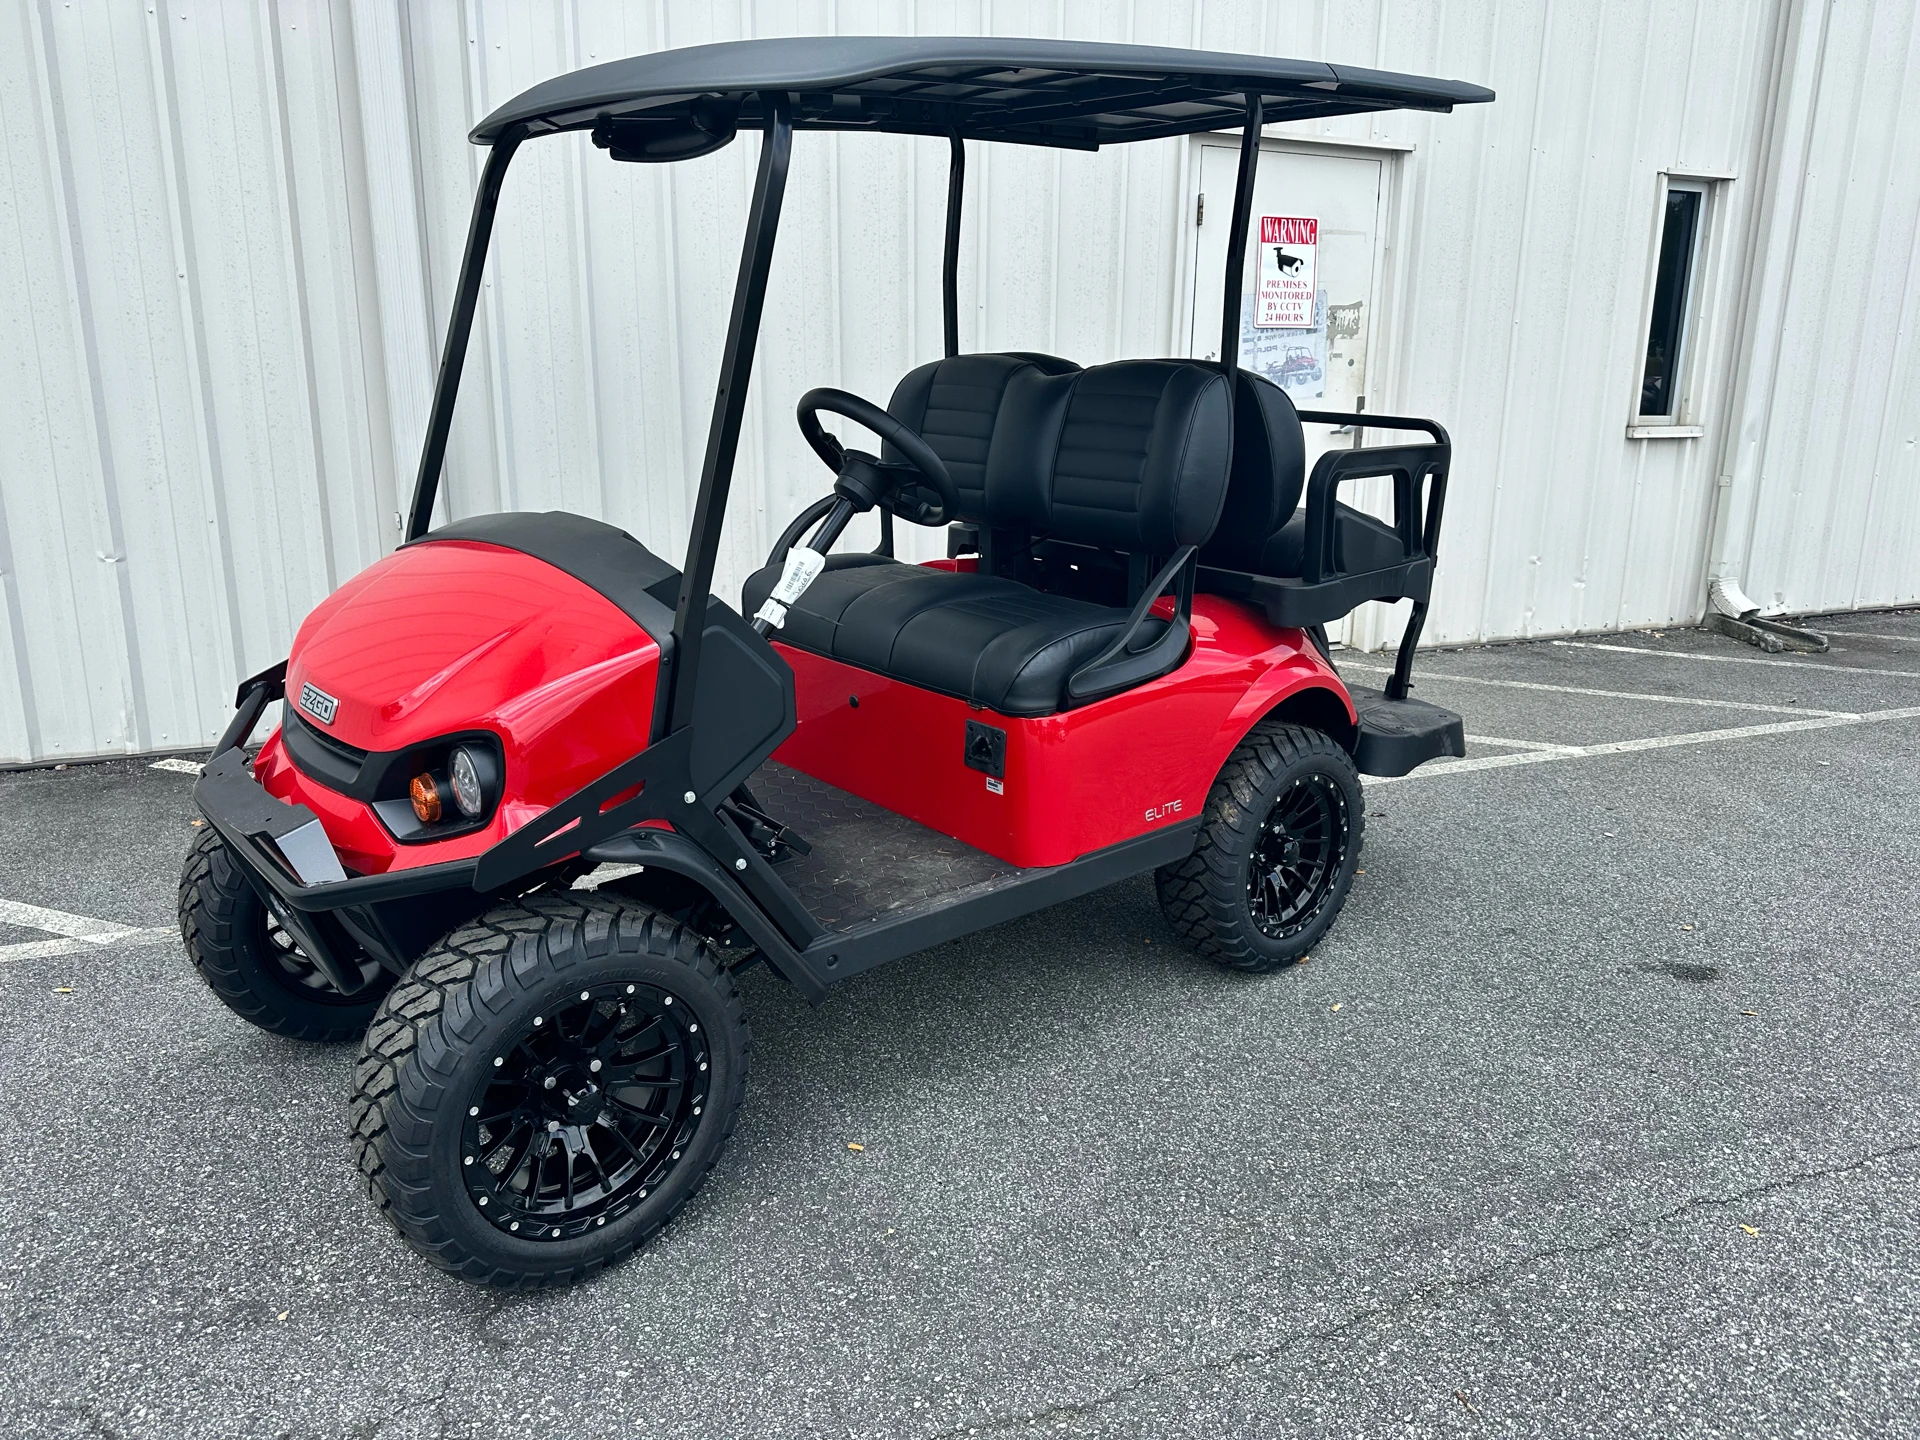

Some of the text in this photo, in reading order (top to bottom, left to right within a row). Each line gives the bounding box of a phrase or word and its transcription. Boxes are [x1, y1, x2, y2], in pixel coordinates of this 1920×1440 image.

[1263, 217, 1316, 244] WARNING
[1266, 280, 1308, 289] PREMISES
[1260, 290, 1312, 300] MONITORED
[1267, 302, 1304, 311] BY CCTV
[1264, 313, 1304, 322] 24 HOURS
[300, 685, 334, 720] EZGO
